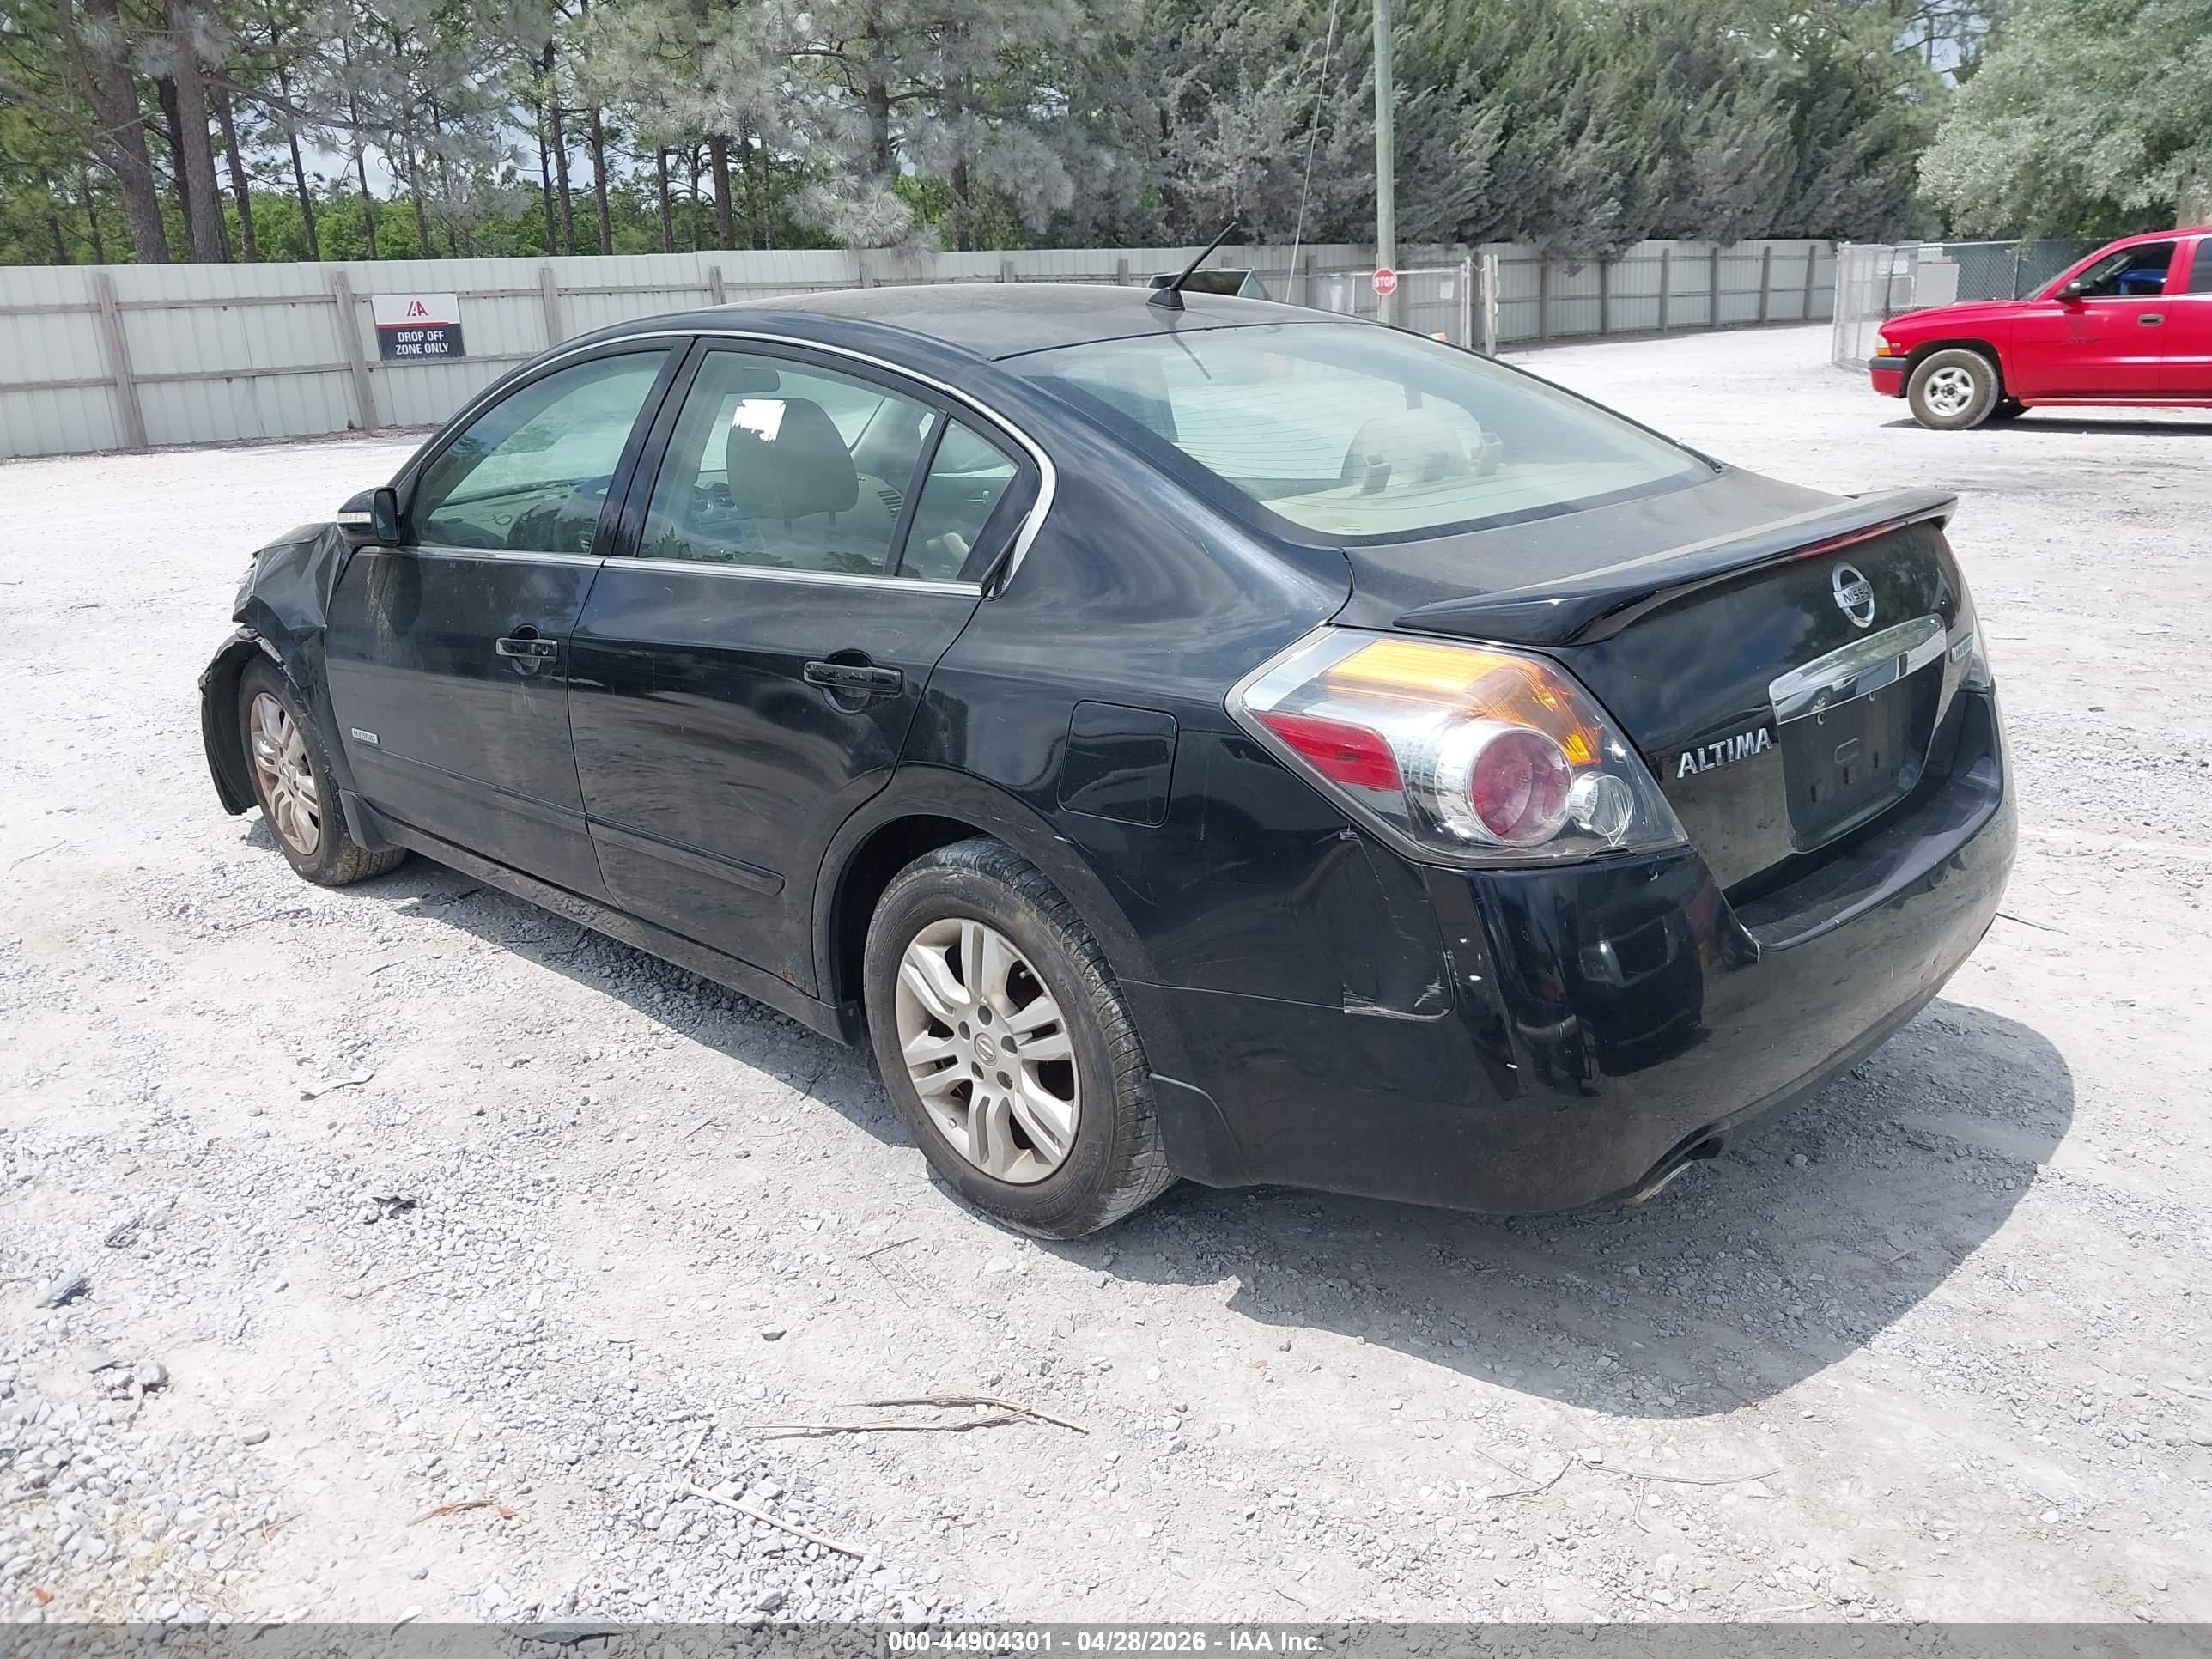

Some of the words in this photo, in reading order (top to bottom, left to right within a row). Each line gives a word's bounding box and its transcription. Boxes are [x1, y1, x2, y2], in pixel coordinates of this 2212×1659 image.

[1374, 276, 1395, 288] STOP
[398, 331, 424, 343] DROP
[427, 331, 444, 341] OFF
[395, 343, 422, 355] ZONE
[424, 343, 449, 354] ONLY
[1676, 727, 1773, 779] ALTIMA
